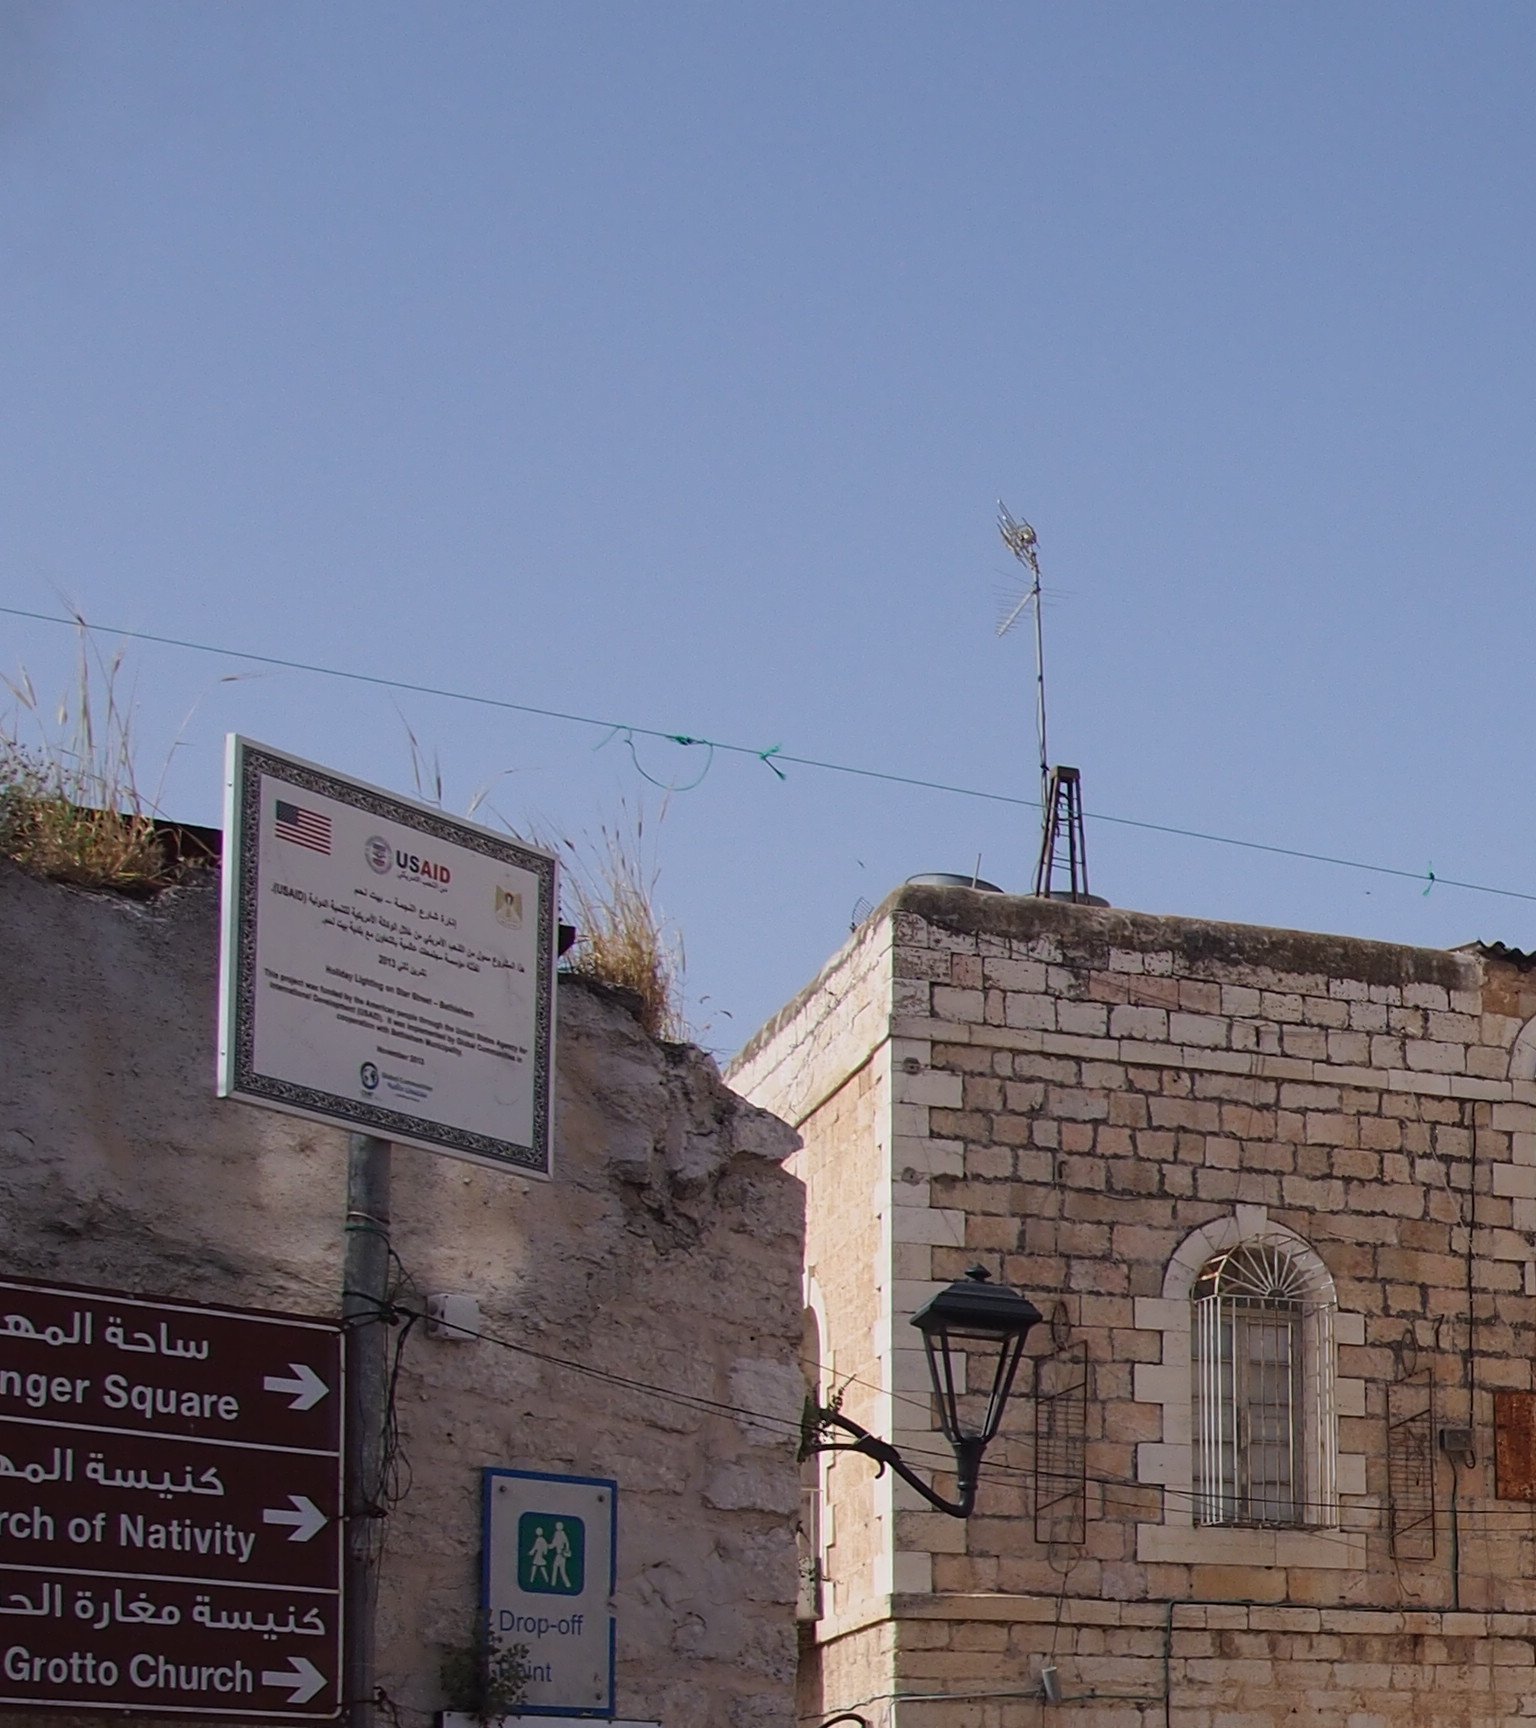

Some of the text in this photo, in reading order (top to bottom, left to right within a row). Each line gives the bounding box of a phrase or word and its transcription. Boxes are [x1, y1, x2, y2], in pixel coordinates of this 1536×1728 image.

[396, 851, 451, 884] USAID
[0, 1311, 210, 1360] ساحة المه
[0, 1369, 240, 1421] nger Square
[85, 1451, 226, 1500] كنيسة
[68, 1512, 107, 1544] of
[120, 1513, 256, 1563] Nativity
[74, 1589, 181, 1630] مغارة
[192, 1593, 326, 1640] كنيسة
[500, 1610, 584, 1639] Drop-off
[4, 1646, 254, 1695] Grotto Church
